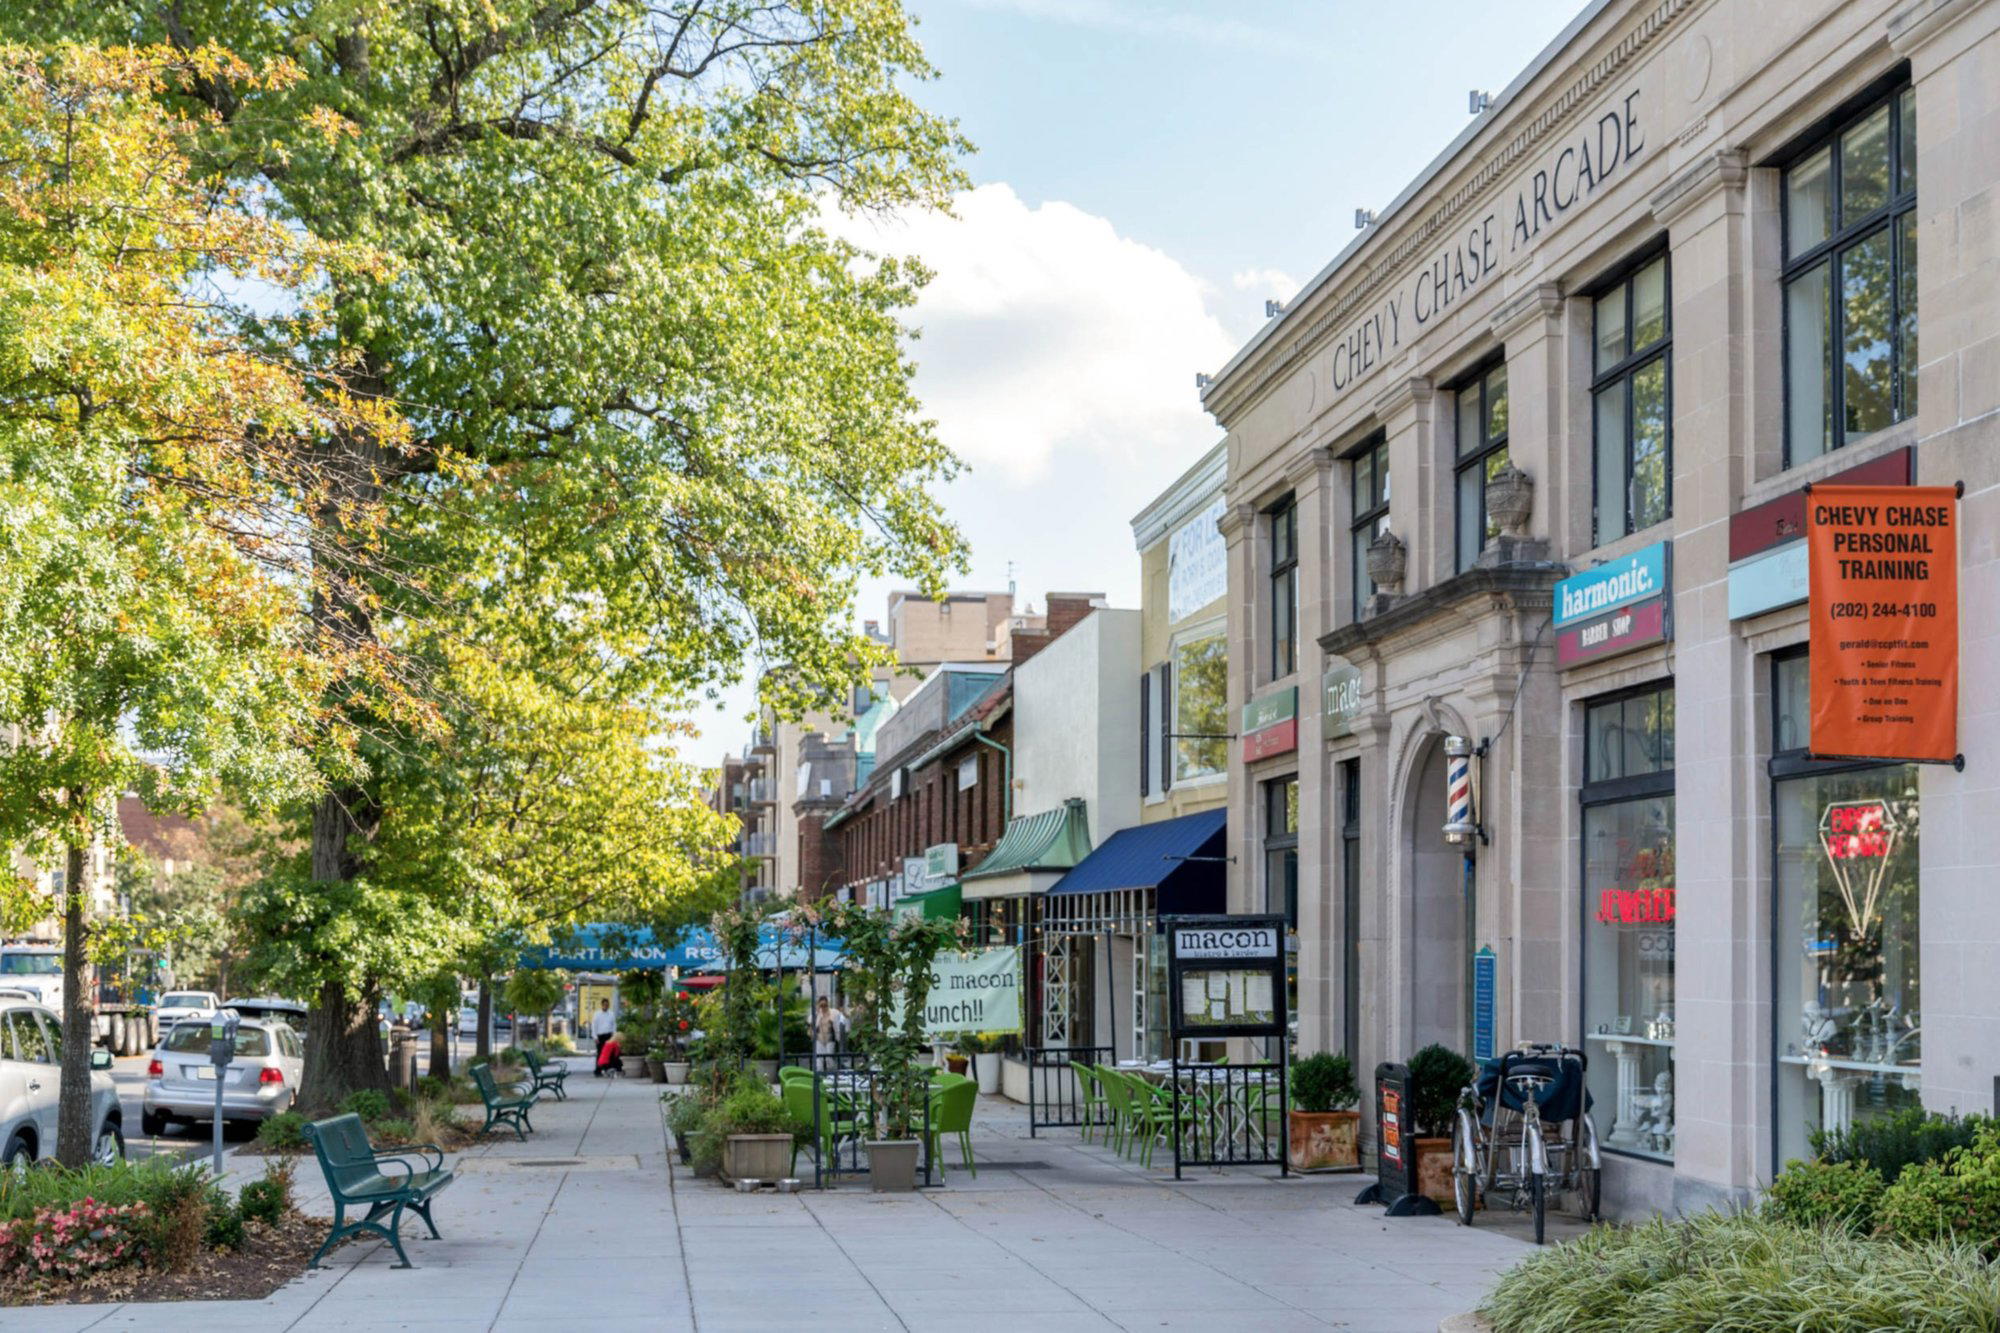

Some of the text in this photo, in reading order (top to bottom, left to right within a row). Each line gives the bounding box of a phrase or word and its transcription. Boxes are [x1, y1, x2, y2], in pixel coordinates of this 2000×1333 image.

[1333, 88, 1645, 391] CHEVY CHASE ARCADE
[1815, 506, 1879, 526] CHEVY
[1886, 506, 1949, 527] CHASE
[1833, 532, 1933, 554] PERSONAL
[1838, 559, 1929, 580] TRAINING
[1562, 559, 1653, 619] harmonic.
[1830, 602, 1937, 620] (202) 244-4100
[1582, 615, 1632, 647] BARBER SHOP
[1866, 660, 1916, 668] Senior Fitness
[1839, 678, 1859, 686] Youth
[1887, 678, 1914, 686] Fitness
[1915, 678, 1942, 687] Training
[1862, 715, 1914, 724] Group Training
[1181, 930, 1272, 949] macon
[950, 972, 1015, 990] macon
